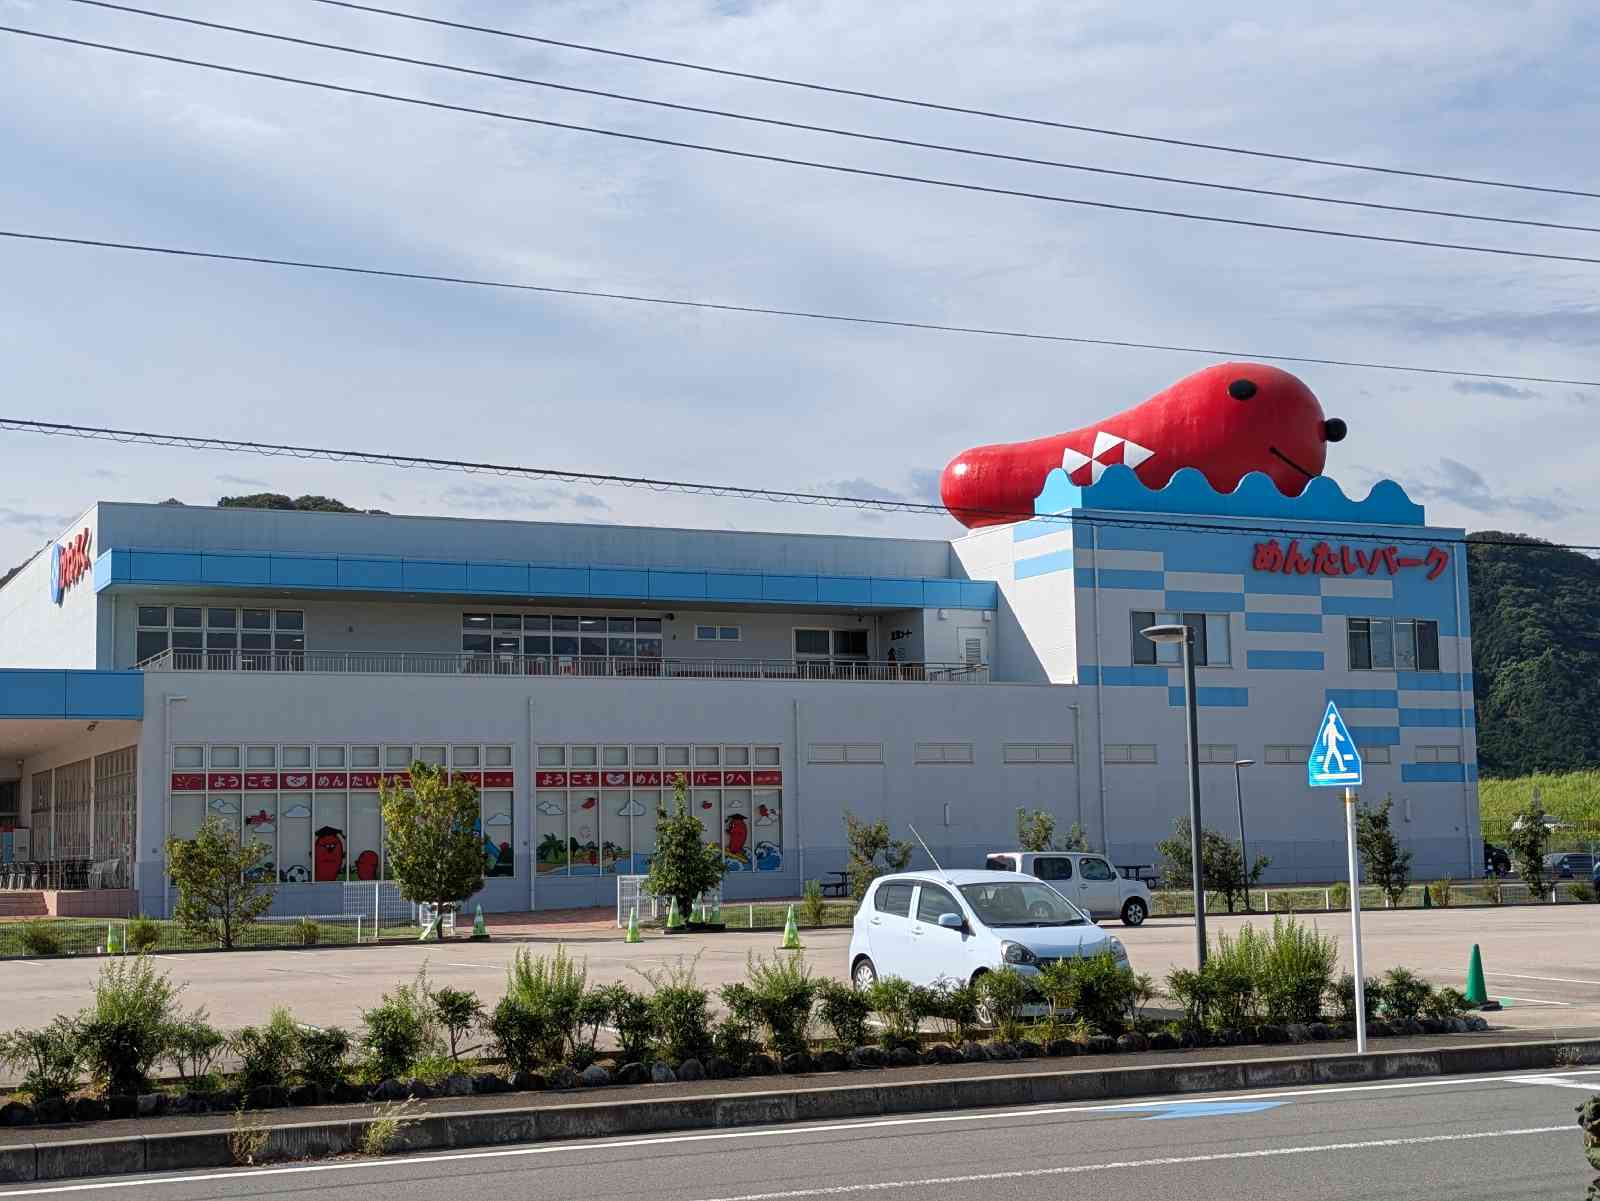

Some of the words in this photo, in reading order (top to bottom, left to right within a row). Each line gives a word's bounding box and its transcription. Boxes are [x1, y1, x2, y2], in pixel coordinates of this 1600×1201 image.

[1253, 539, 1449, 581] めんたいパーク
[213, 775, 273, 788] ようこそ
[542, 773, 593, 785] ようこそ
